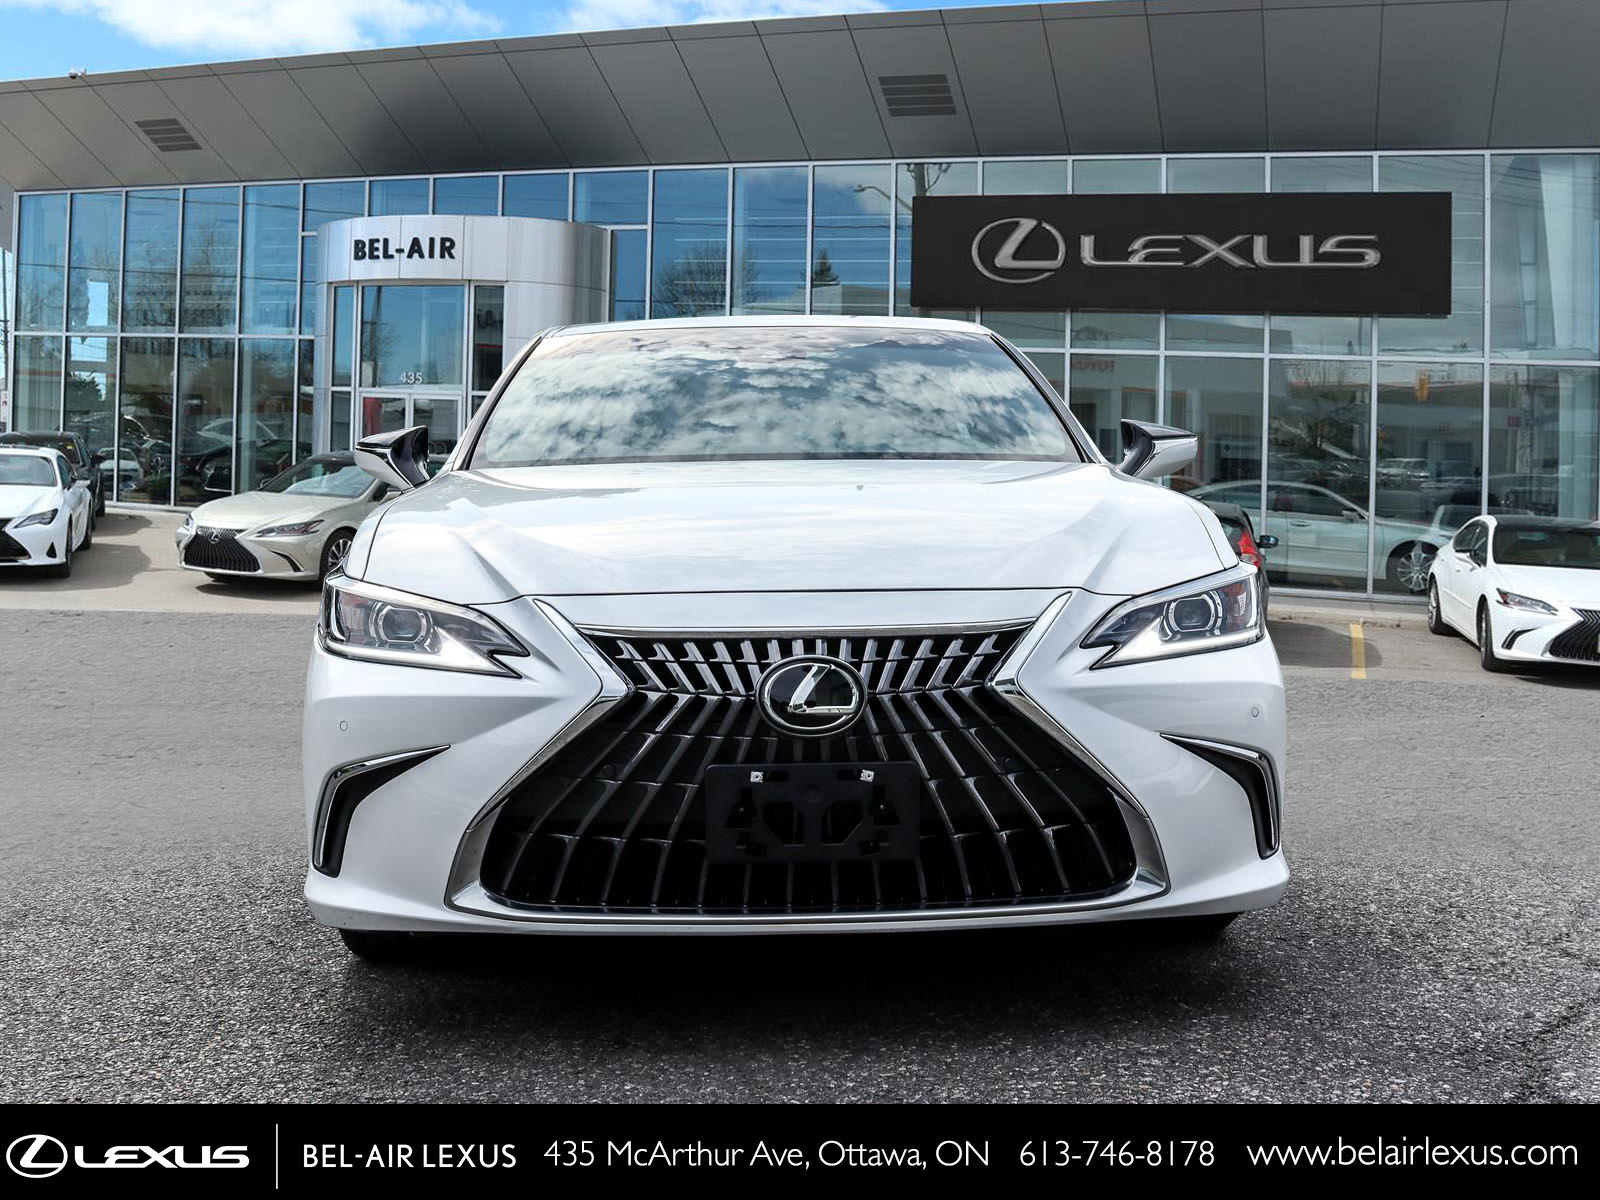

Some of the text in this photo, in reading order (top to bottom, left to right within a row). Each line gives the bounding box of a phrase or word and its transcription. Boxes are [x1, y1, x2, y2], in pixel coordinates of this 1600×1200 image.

[353, 237, 456, 261] BEL-AIR
[1080, 234, 1382, 268] LEXUS
[400, 371, 423, 384] 435
